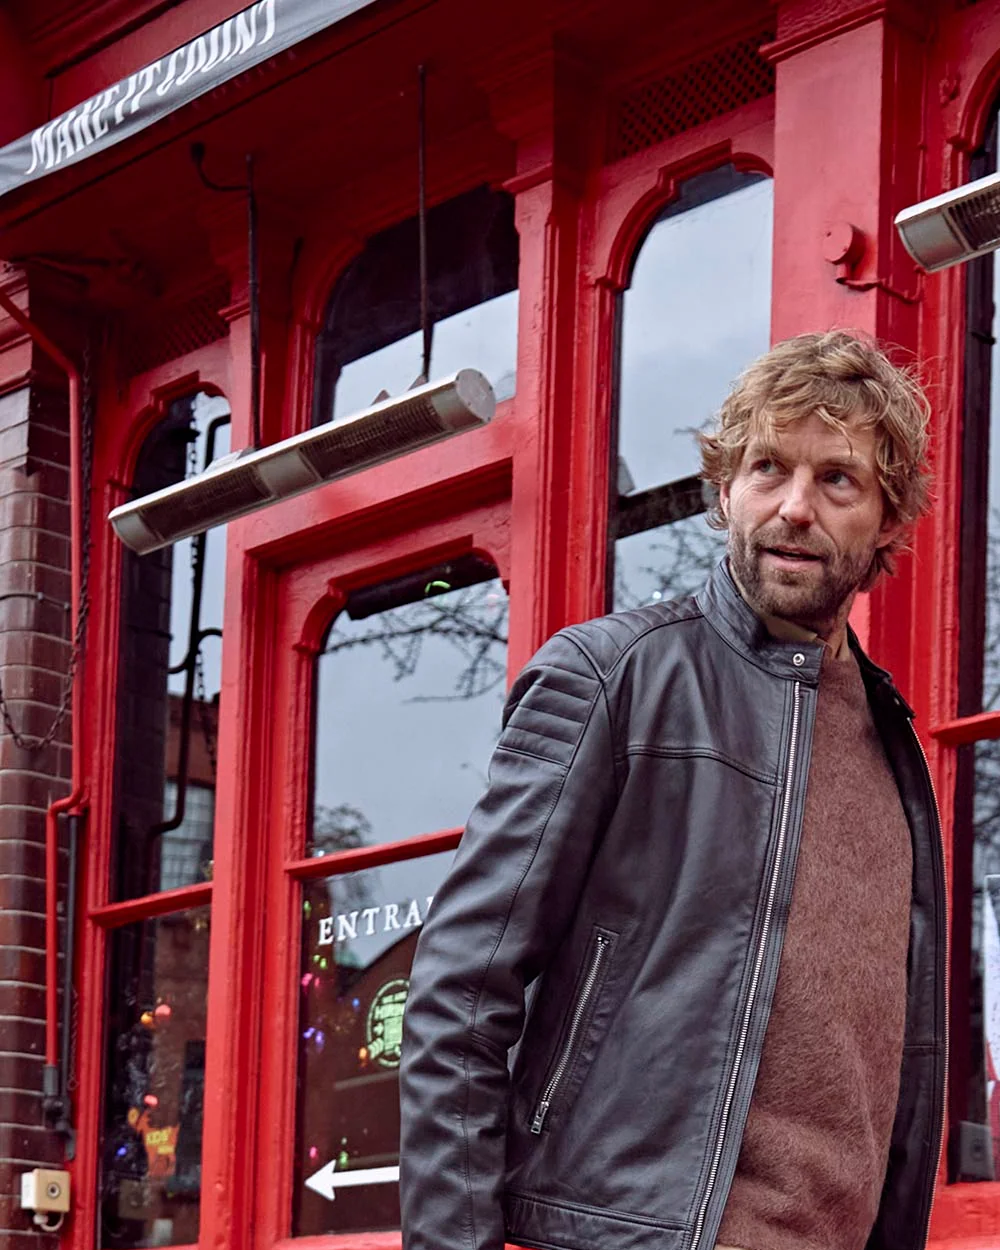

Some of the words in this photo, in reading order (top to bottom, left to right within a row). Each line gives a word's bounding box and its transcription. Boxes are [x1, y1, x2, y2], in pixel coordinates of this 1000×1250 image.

[24, 84, 120, 175] MAKE
[115, 60, 162, 125] IT
[156, 0, 276, 96] COUNT
[318, 895, 435, 945] ENTRA
